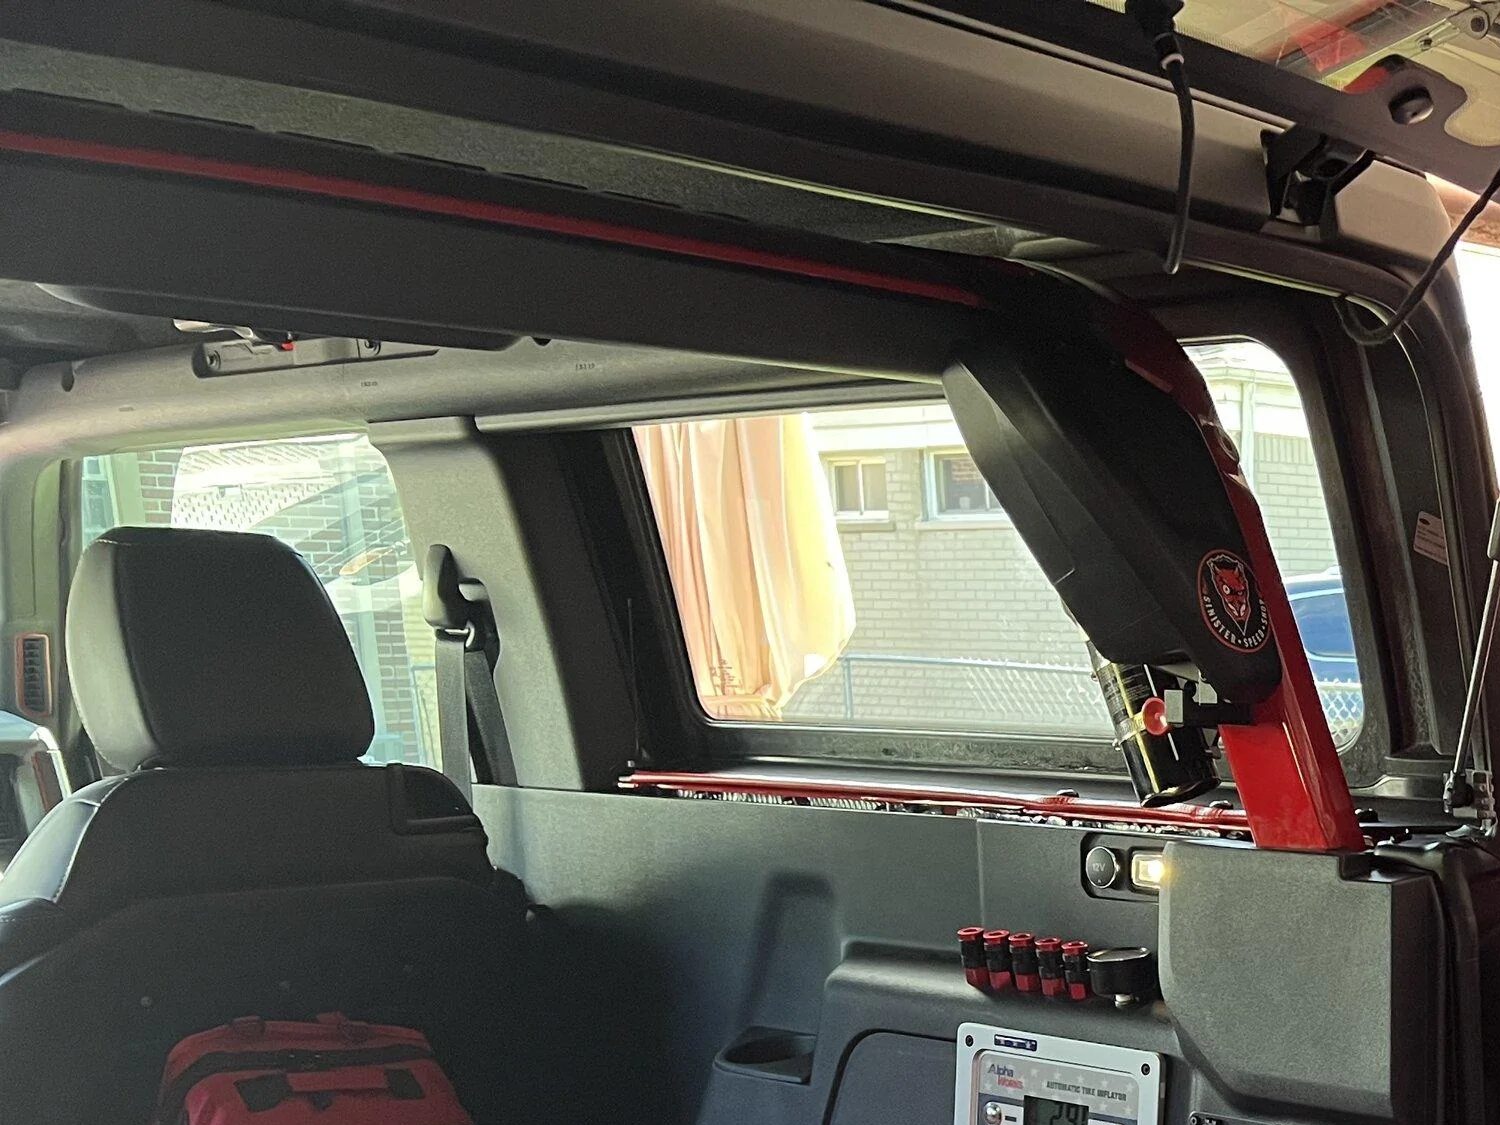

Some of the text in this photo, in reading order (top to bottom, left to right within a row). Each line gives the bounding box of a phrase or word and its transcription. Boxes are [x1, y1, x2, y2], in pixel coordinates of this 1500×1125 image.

[1202, 595, 1236, 645] SINISTER
[1243, 630, 1265, 648] SPEED
[1092, 862, 1106, 872] 12V
[988, 1063, 1014, 1078] Alpha
[1046, 1081, 1127, 1101] AUTOMATIC TIRE INFLATOR
